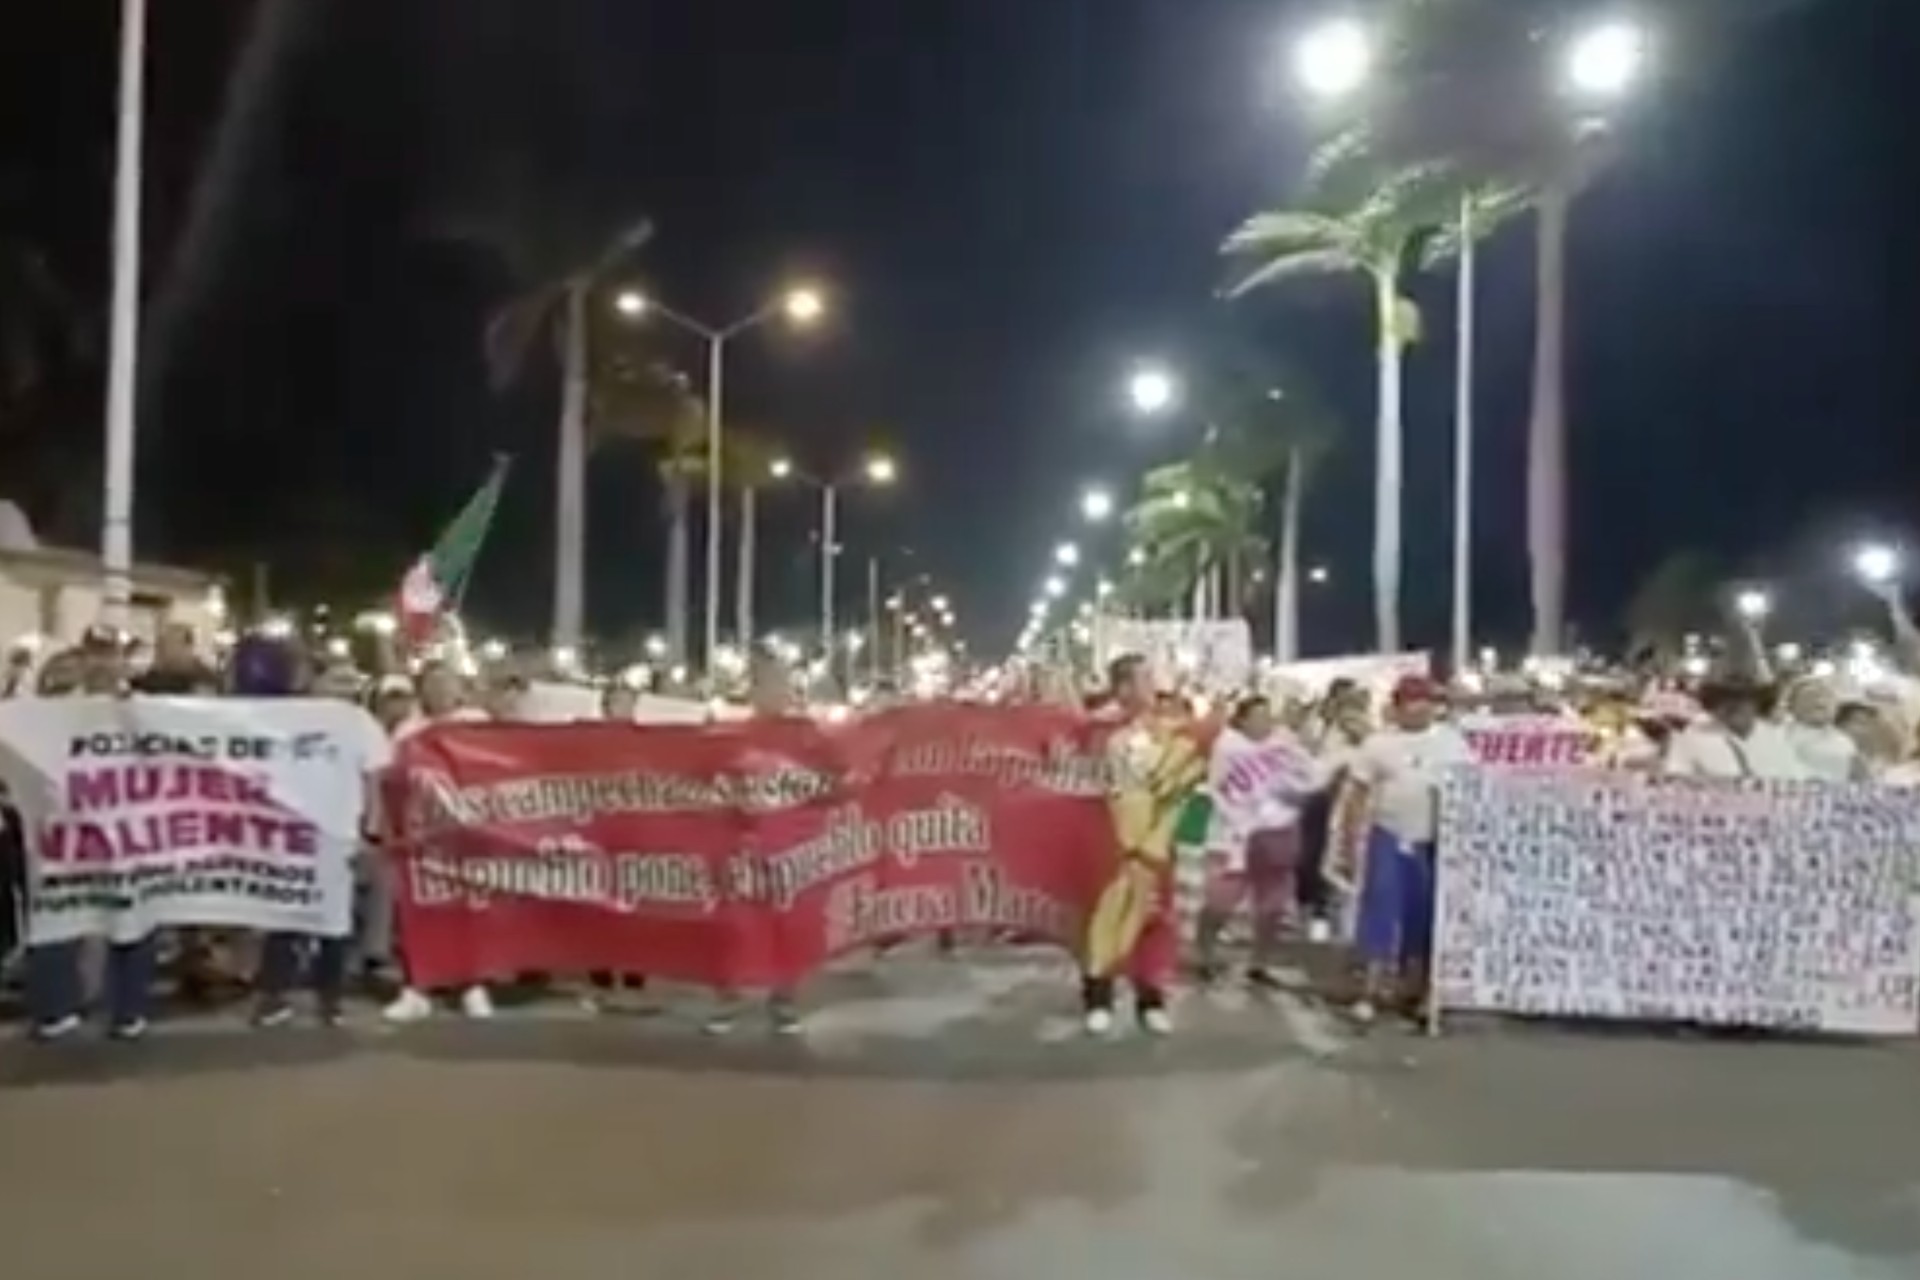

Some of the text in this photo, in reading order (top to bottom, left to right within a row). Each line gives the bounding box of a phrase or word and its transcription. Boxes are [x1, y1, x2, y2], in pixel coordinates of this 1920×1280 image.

[227, 737, 272, 759] DE
[67, 764, 270, 811] MUJER
[38, 812, 318, 862] VALIENTE
